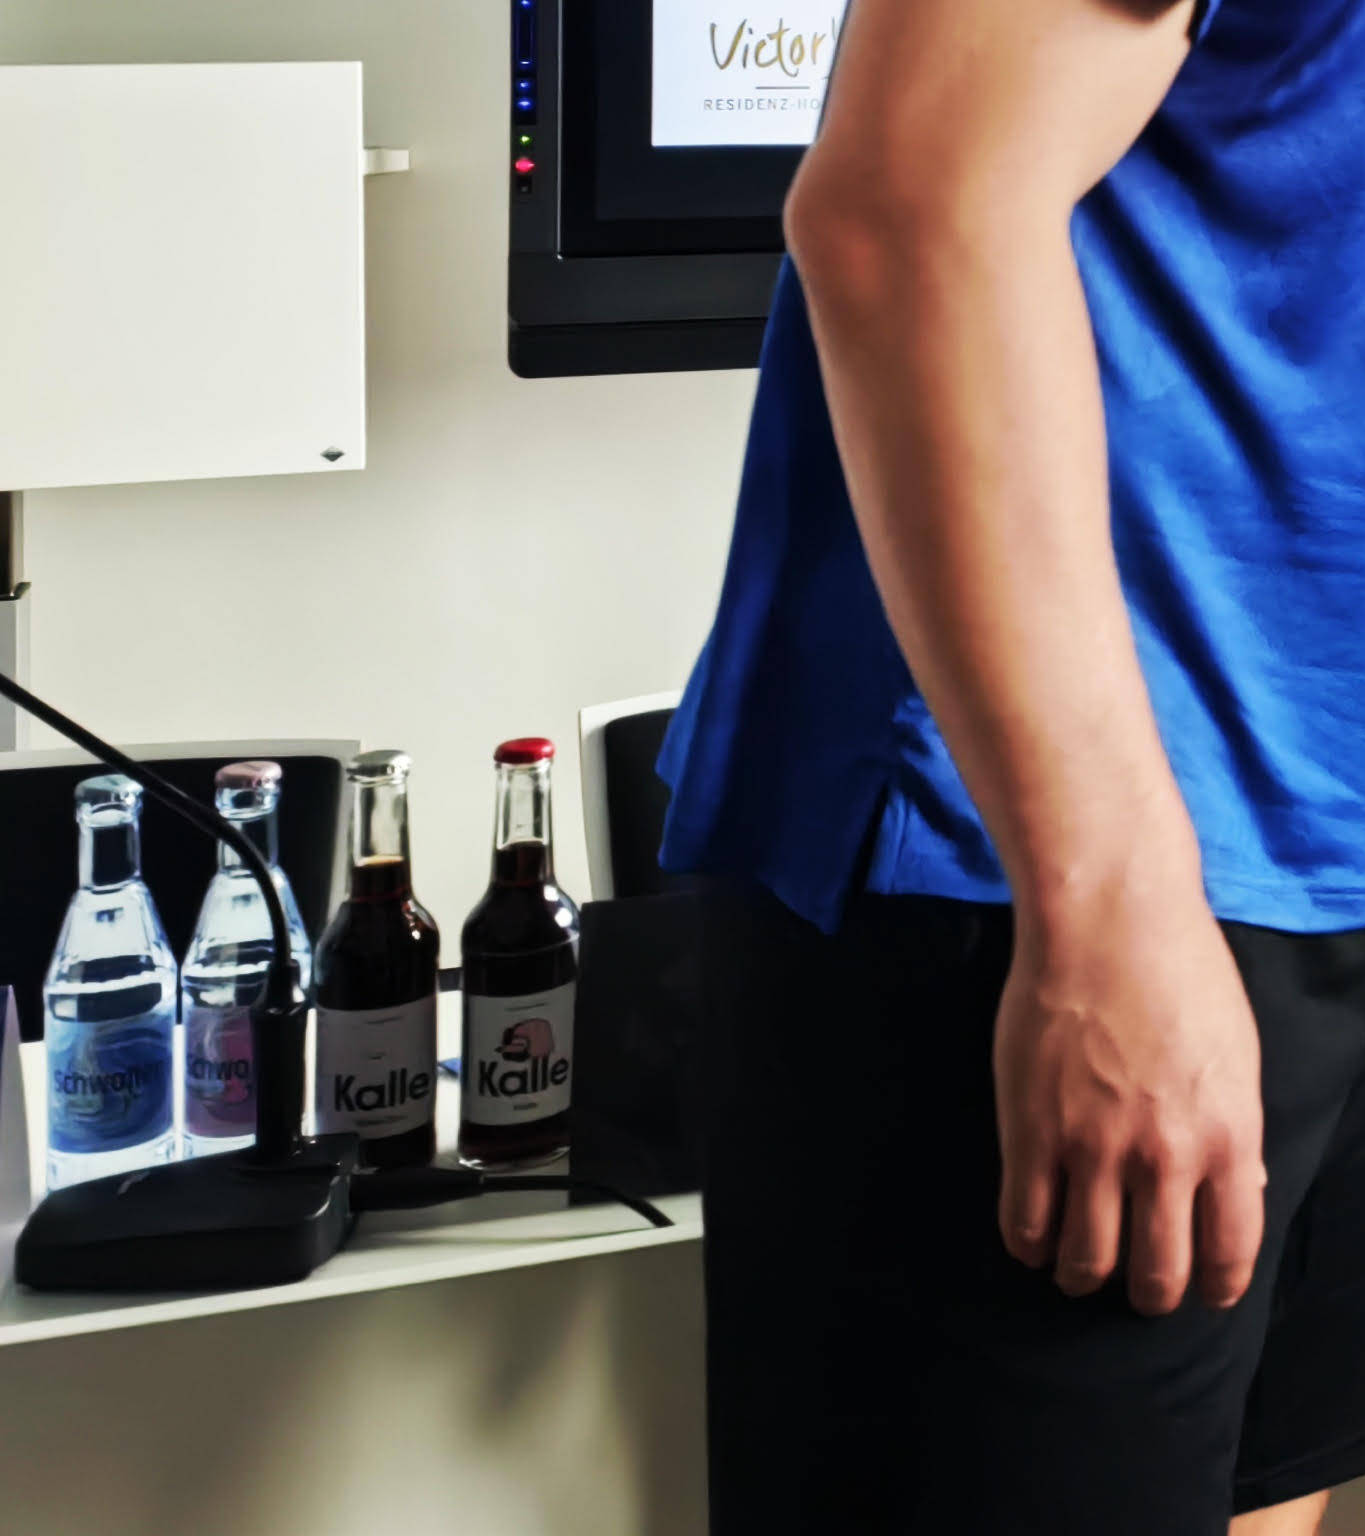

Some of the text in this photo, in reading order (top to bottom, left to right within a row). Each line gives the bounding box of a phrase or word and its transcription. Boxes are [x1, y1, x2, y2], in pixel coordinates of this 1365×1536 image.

[709, 17, 838, 81] Victor'
[703, 97, 820, 111] RESIDENZ-HO
[334, 1068, 430, 1113] Kalle
[478, 1056, 570, 1098] Kalle
